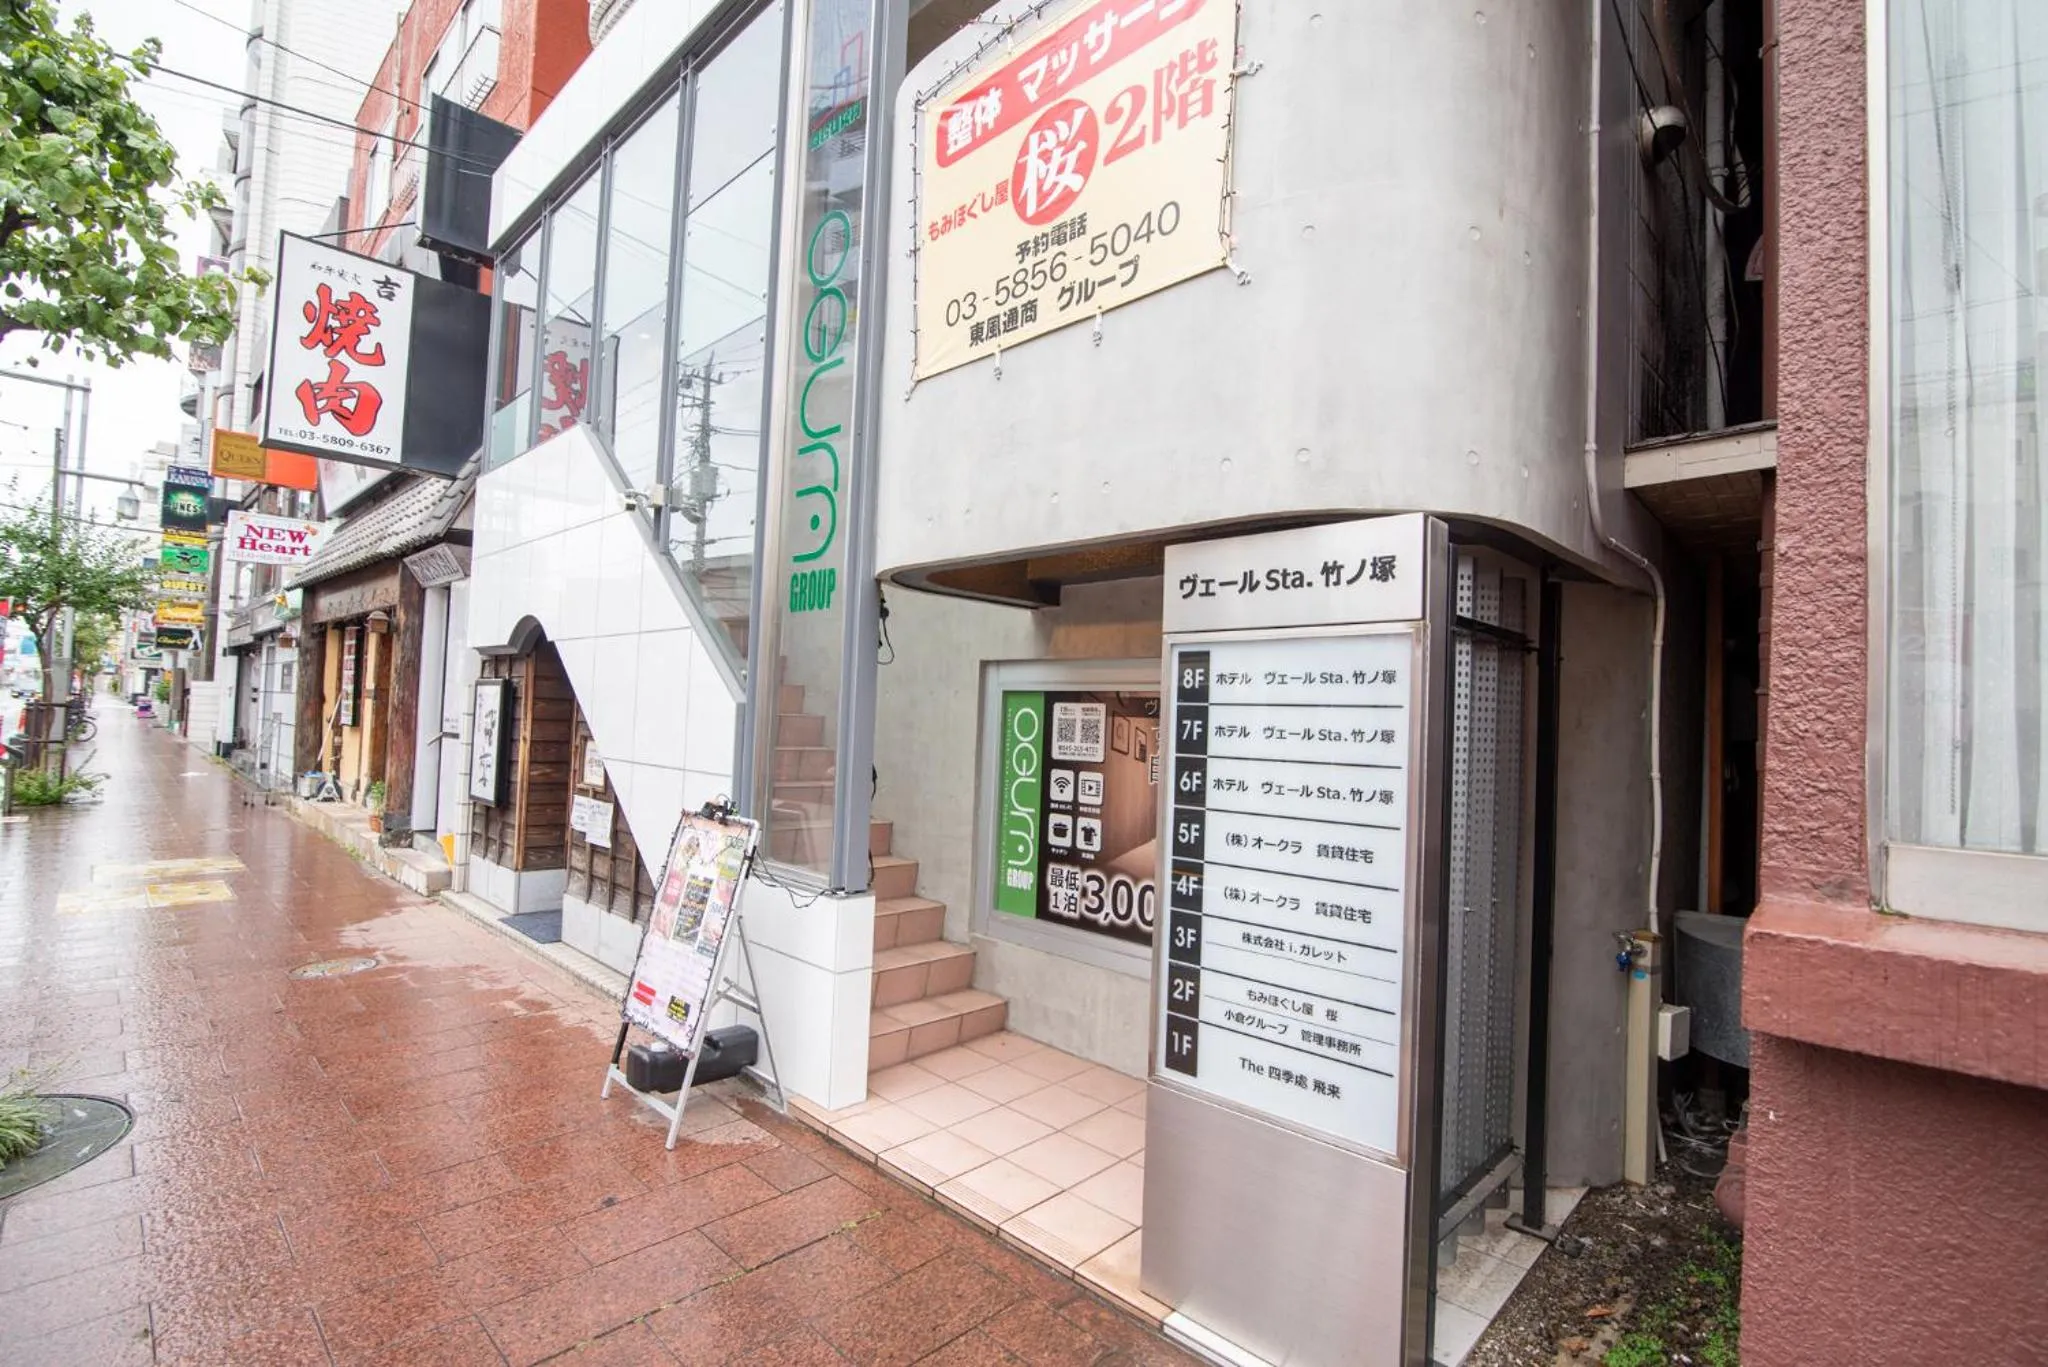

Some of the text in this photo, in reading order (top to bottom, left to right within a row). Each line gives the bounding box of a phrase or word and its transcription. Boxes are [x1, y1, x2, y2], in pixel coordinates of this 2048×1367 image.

[1102, 37, 1219, 168] 2階
[1017, 106, 1090, 218] 桜
[928, 178, 1009, 242] もみほぐし屋
[1015, 212, 1088, 264] 予約電話
[945, 200, 1181, 327] 03-5856-5040
[371, 274, 402, 302] 吉
[969, 254, 1141, 347] 東風通商 グループ
[295, 282, 386, 436] 焼肉
[243, 523, 309, 544] NEW
[236, 536, 313, 557] Heart
[789, 567, 836, 613] GROUP
[1183, 668, 1205, 690] 8F
[1215, 672, 1252, 686] ホテル
[1181, 719, 1202, 741] 7F
[1214, 725, 1250, 739] ホテル
[1179, 771, 1202, 793] 6F
[1213, 777, 1248, 793] ホテル
[1177, 822, 1200, 845] 5F
[1316, 843, 1375, 864] 賃貸住宅
[1050, 867, 1080, 892] 最低
[1176, 875, 1199, 897] 4F
[1052, 891, 1079, 915] 1泊
[1315, 901, 1372, 925] 賃貸住宅
[1174, 926, 1197, 949] 3F
[1173, 979, 1195, 1002] 2F
[1247, 989, 1339, 1023] もみほぐし屋 桜
[1171, 1030, 1193, 1056] 1F
[1300, 1028, 1362, 1056] 管理事務所
[1239, 1056, 1265, 1076] The
[1312, 1078, 1341, 1100] 飛来
